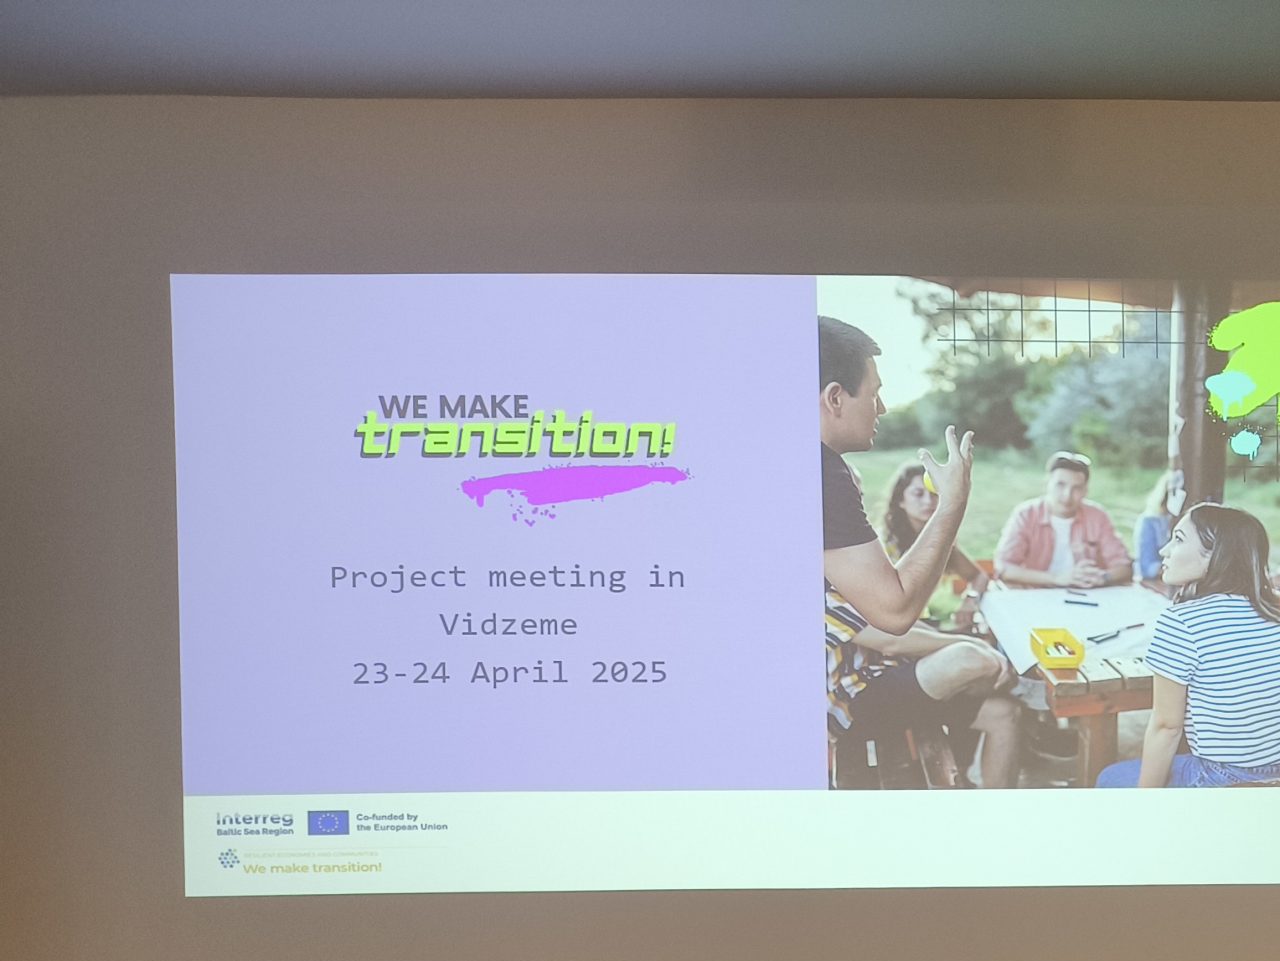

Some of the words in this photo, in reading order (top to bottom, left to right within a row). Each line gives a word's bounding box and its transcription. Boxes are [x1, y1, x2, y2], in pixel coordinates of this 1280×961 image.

[378, 395, 428, 419] WE
[439, 395, 529, 418] MAKE
[354, 410, 677, 459] transition!
[331, 564, 467, 593] Project
[488, 564, 626, 593] meeting
[649, 565, 685, 588] in
[439, 613, 578, 636] Vidzeme
[353, 662, 451, 684] 23-24
[470, 661, 569, 688] April
[591, 661, 668, 683] 2025
[216, 812, 294, 826] Interreg
[356, 813, 405, 821] Co-funded
[406, 813, 419, 822] by
[216, 828, 242, 836] Baltic
[243, 827, 261, 835] Sea
[261, 827, 294, 836] Region
[373, 823, 419, 832] European
[243, 863, 266, 874] We
[270, 863, 310, 873] make
[312, 862, 383, 873] transition!
